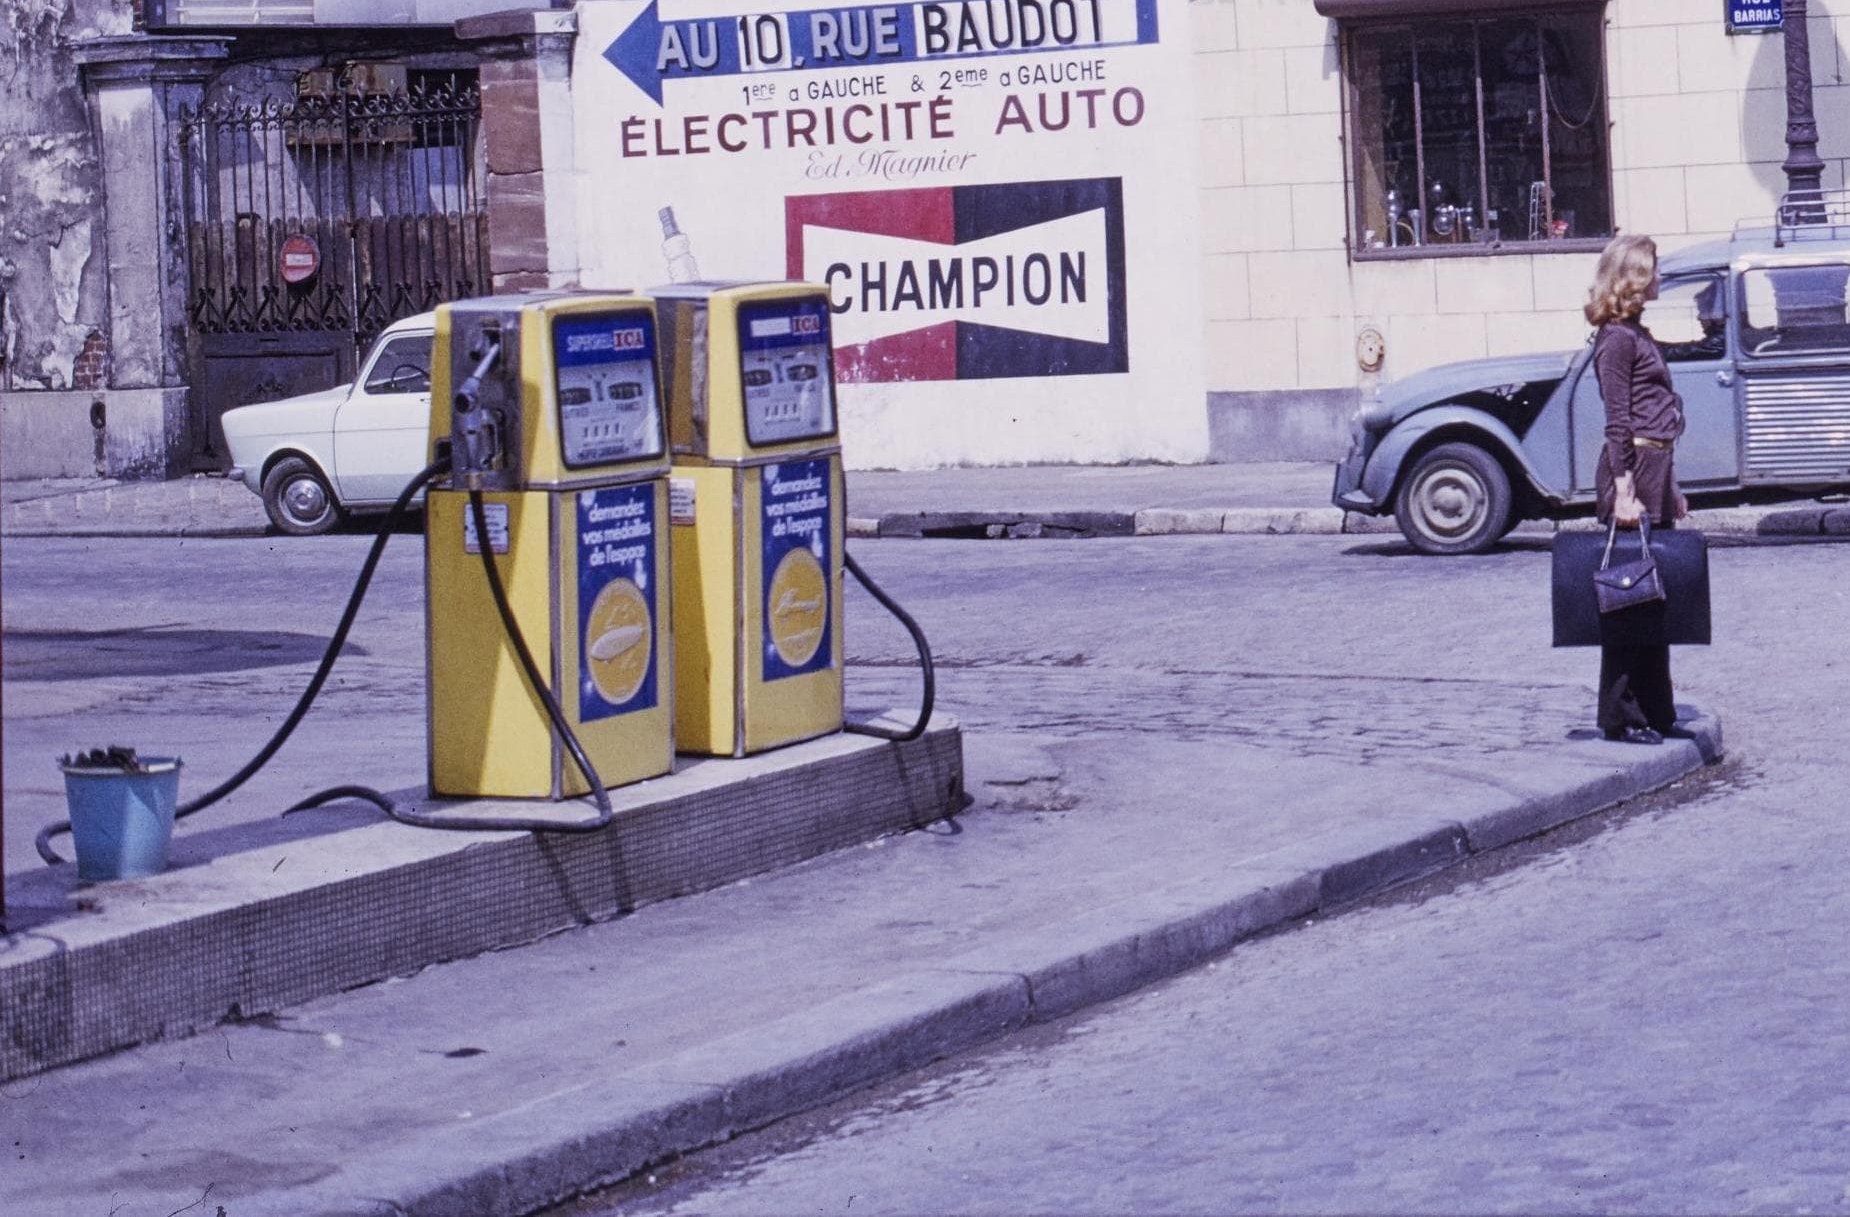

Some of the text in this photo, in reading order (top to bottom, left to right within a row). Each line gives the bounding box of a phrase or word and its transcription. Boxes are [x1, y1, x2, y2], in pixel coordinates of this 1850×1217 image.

[656, 21, 720, 72] AU
[810, 7, 901, 60] RUE
[1734, 9, 1780, 23] BARRIAS
[807, 75, 887, 100] GAUCHE
[910, 74, 925, 93] &
[1017, 60, 1106, 85] GAUCHE
[620, 87, 1145, 158] ÉLECTRICITÉ AUTO
[857, 149, 977, 181] Magnier
[825, 251, 1087, 314] CHAMPION
